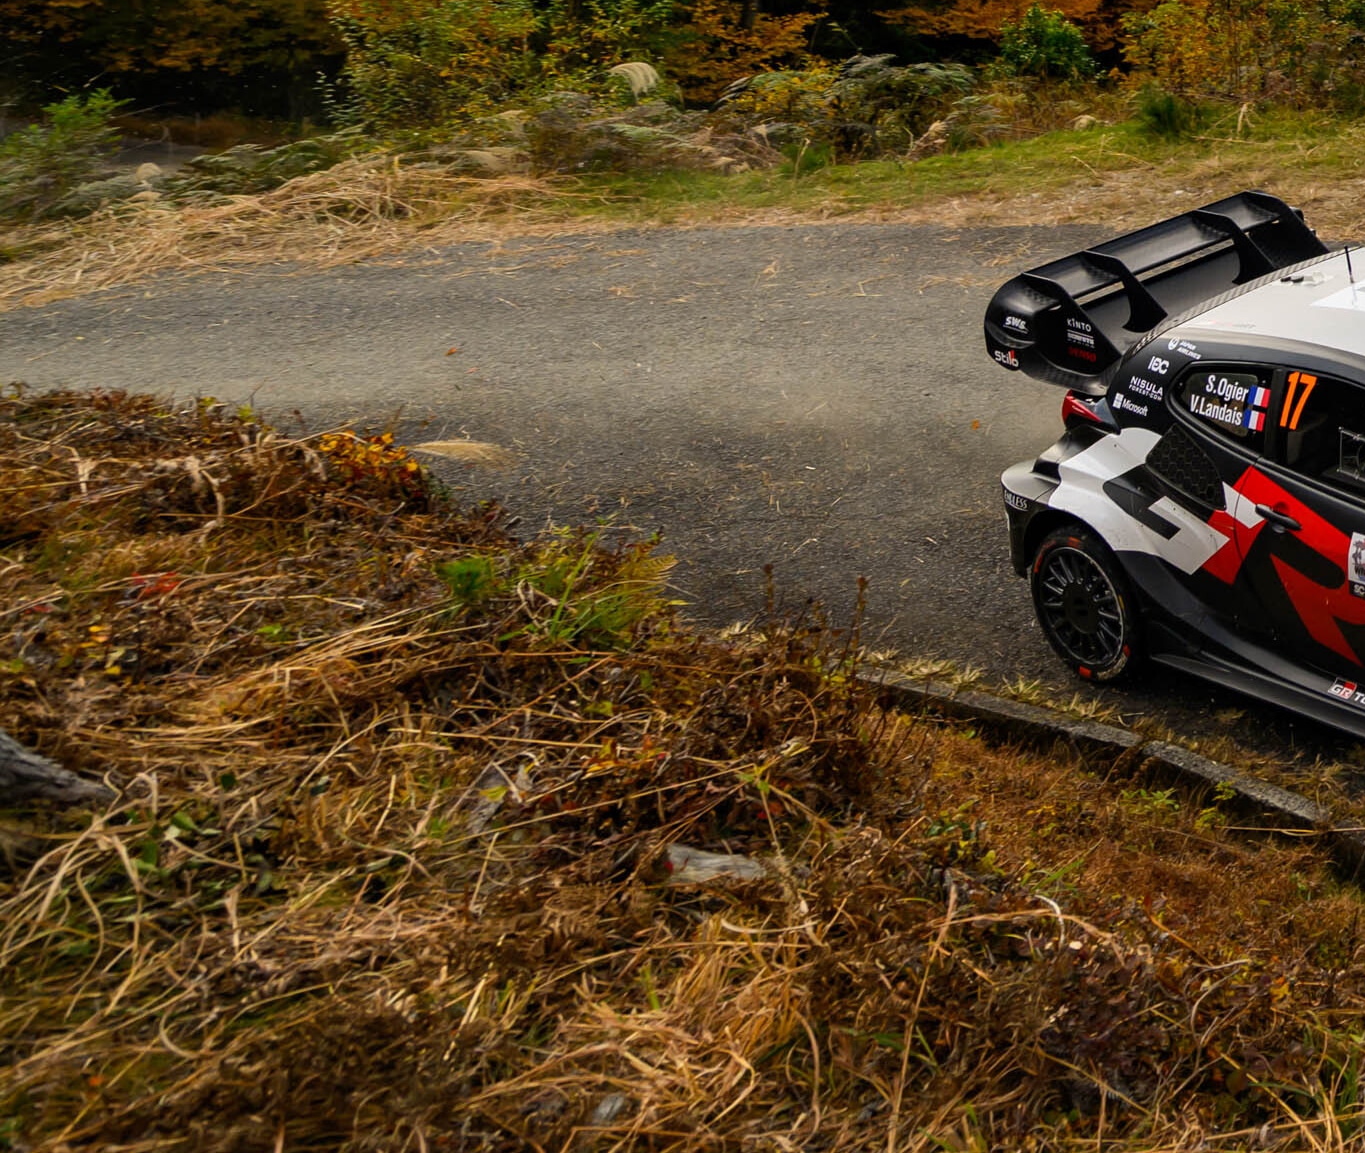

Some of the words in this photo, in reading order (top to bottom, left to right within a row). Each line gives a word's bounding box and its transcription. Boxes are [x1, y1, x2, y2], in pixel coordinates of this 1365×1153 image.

[994, 349, 1019, 367] Stilo
[1130, 376, 1163, 396] NISULA
[1206, 375, 1249, 402] S.Ogier
[1122, 399, 1148, 416] Microsoft
[1190, 394, 1242, 426] V.Landais
[1280, 371, 1318, 430] 17
[1328, 681, 1355, 700] GR
